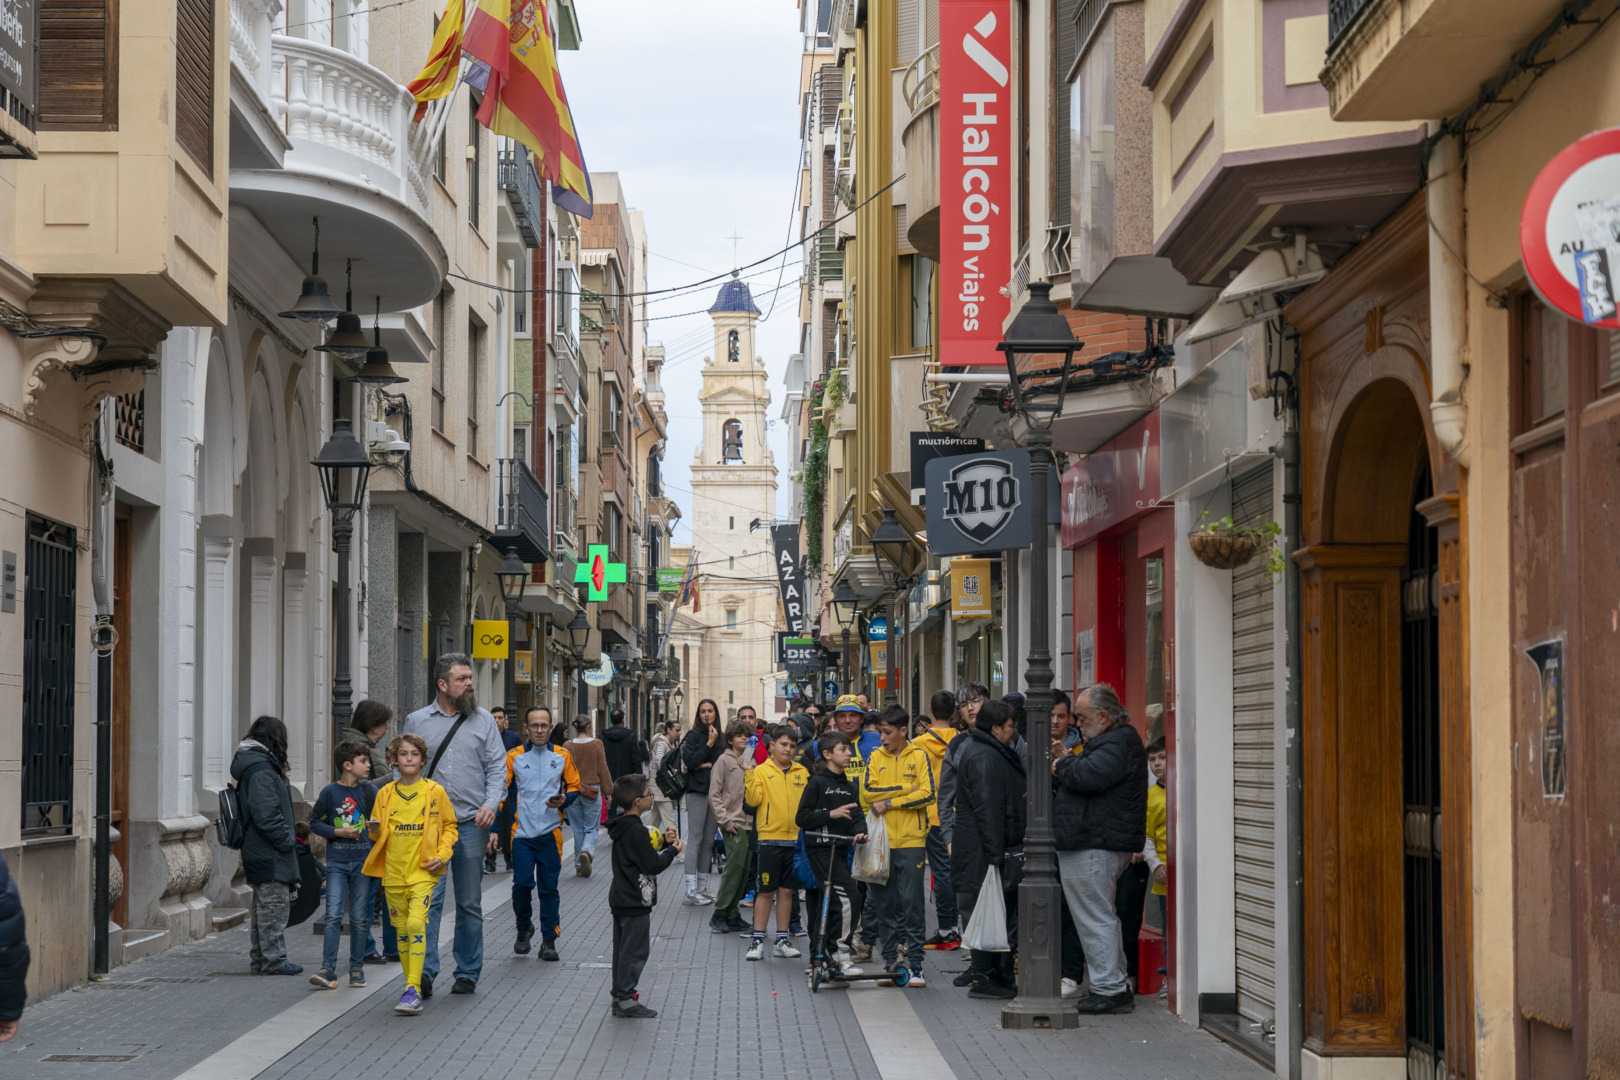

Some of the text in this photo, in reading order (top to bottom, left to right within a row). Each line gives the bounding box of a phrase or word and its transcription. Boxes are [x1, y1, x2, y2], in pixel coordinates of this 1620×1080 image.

[959, 93, 1000, 332] Halcón viajes
[943, 476, 1021, 519] M10
[586, 673, 605, 682] viajes
